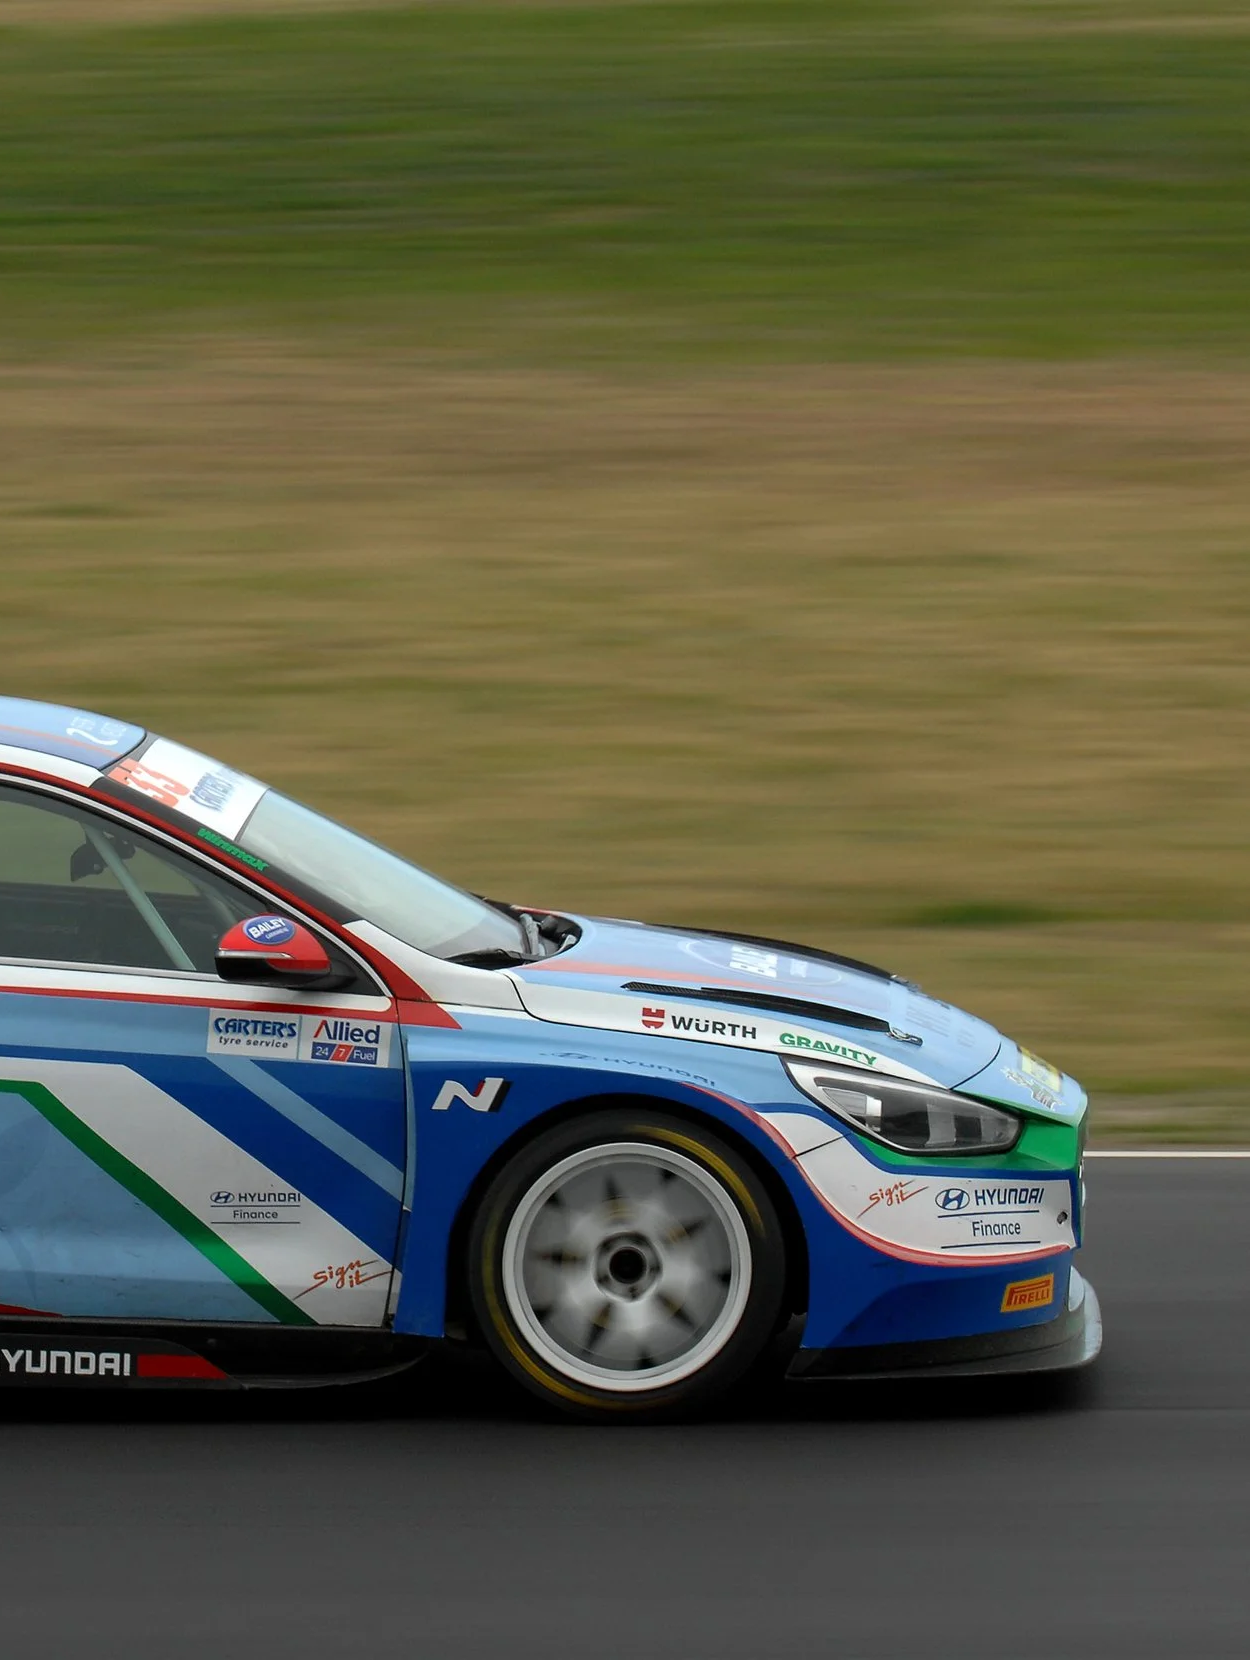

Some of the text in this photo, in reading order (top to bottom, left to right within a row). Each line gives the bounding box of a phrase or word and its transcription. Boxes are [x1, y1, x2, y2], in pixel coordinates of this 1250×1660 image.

[248, 918, 286, 939] BAILEY
[214, 1017, 297, 1038] CARTER'S
[314, 1020, 380, 1044] Allied
[219, 1036, 288, 1049] tyre service
[779, 1033, 878, 1066] GRAVITY
[315, 1047, 375, 1061] 24 7 Fuel
[604, 1058, 715, 1087] HYUNDAI
[238, 1192, 301, 1203] HYUNDAI
[974, 1188, 1044, 1206] HYUNDAI
[233, 1209, 278, 1219] Finance
[972, 1222, 1020, 1237] Finance
[1006, 1280, 1050, 1306] PIRELLI
